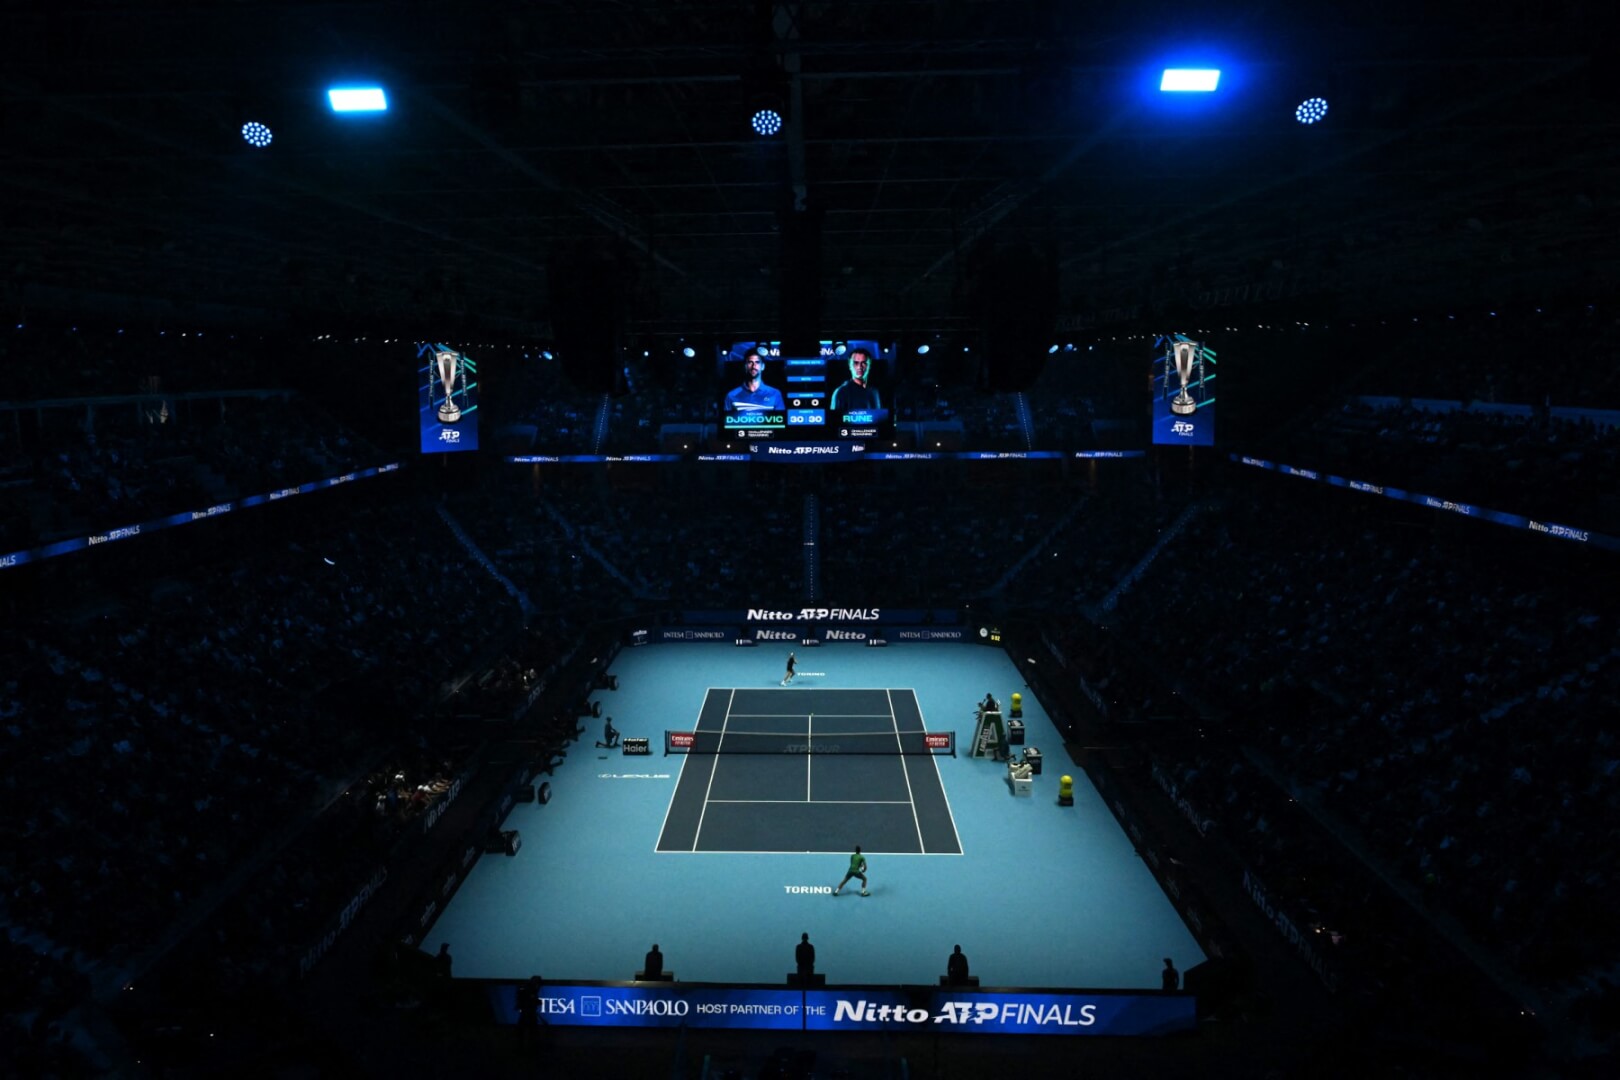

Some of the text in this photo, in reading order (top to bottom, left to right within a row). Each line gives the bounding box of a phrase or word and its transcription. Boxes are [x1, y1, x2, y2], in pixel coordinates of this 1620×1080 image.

[726, 416, 783, 424] DJOKOVIC
[842, 415, 873, 423] RUNE
[768, 446, 792, 454] Nitto
[812, 446, 839, 454] FINALS
[88, 535, 108, 546] Nitto
[121, 524, 140, 537] FINALS
[1529, 521, 1549, 533] Nitto
[1564, 528, 1588, 542] FINALS
[747, 608, 880, 620] Nitto ATP FINALS
[756, 630, 797, 640] Nitto
[826, 630, 866, 640] Nitto
[623, 744, 648, 753] Haier
[784, 885, 833, 895] TORINO
[538, 997, 1096, 1026] TESA SANPAOLO HOST PARTNER OF THE Nitto ATP FINALS
